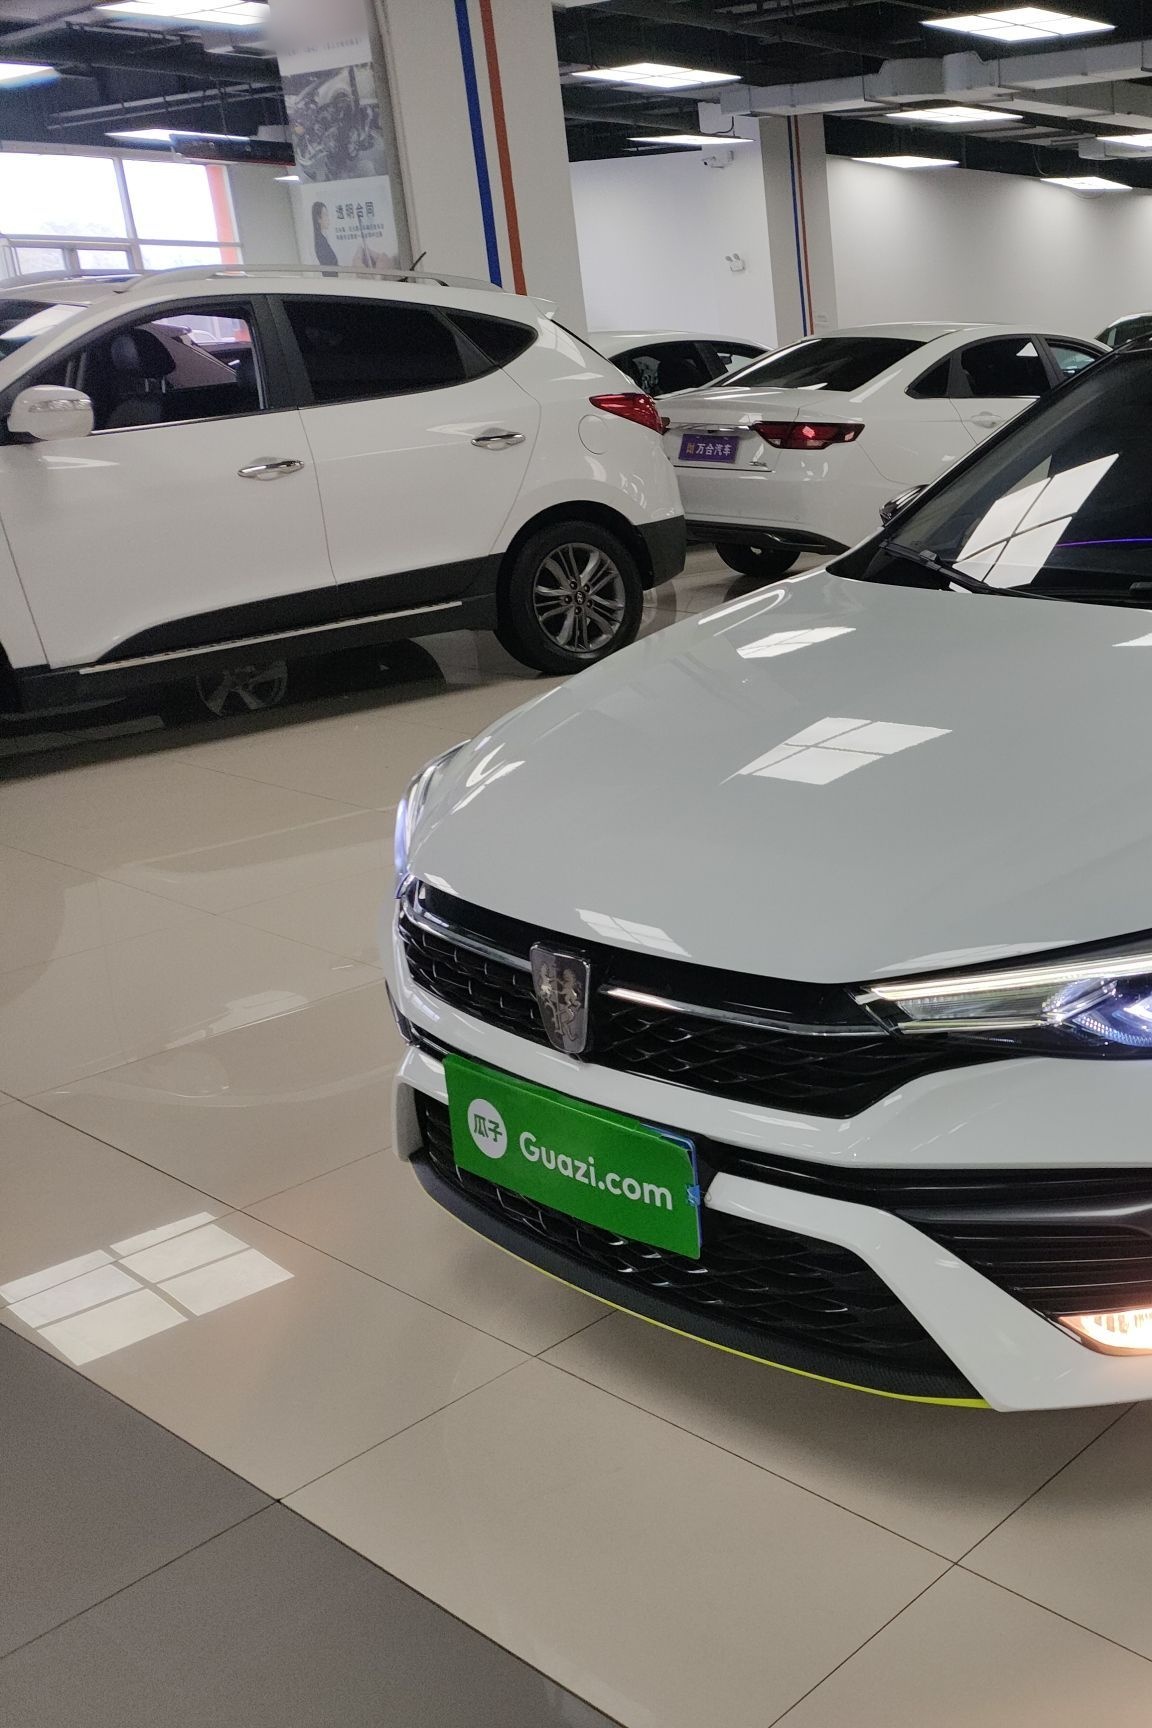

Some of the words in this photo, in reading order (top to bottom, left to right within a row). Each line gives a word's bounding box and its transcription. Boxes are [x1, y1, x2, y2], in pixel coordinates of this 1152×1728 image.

[336, 201, 375, 220] 透明合同
[696, 443, 732, 456] 万合汽车
[473, 1113, 503, 1142] 瓜子
[519, 1131, 673, 1210] Guazi.com
